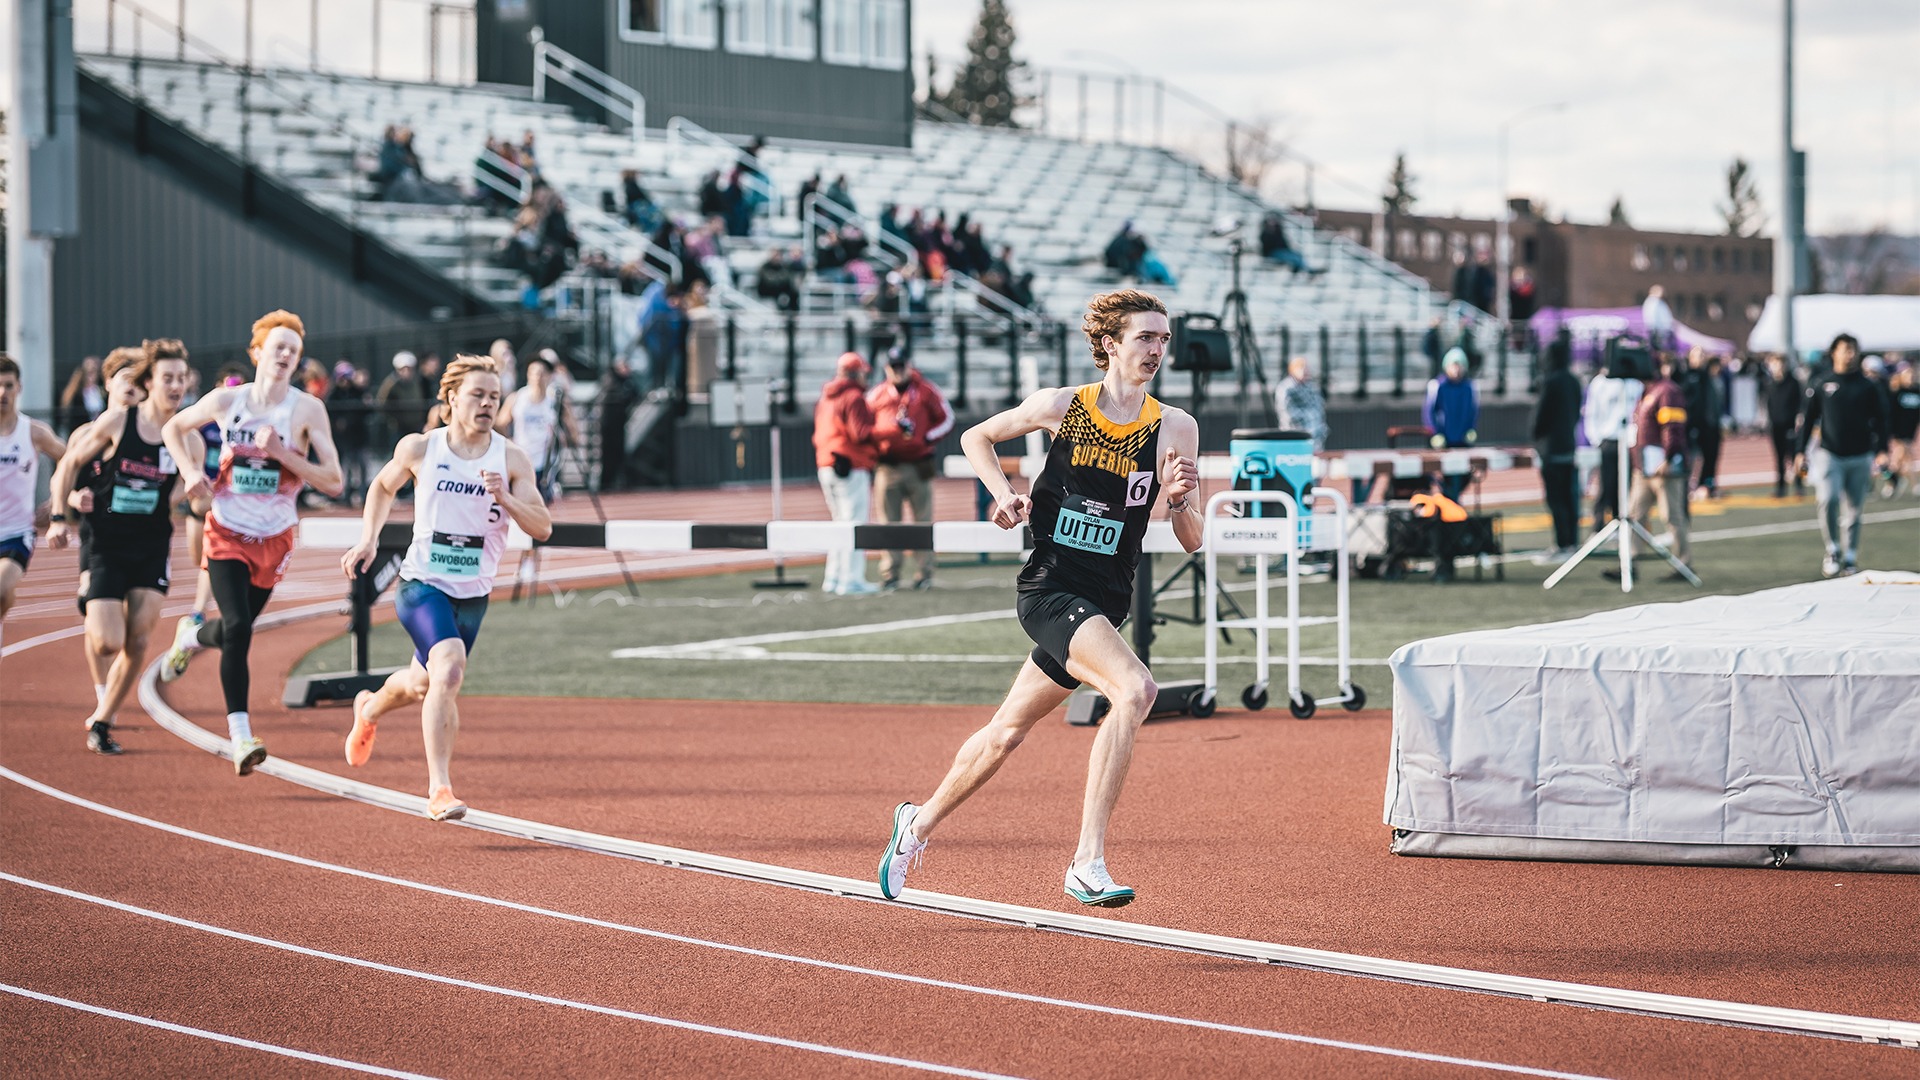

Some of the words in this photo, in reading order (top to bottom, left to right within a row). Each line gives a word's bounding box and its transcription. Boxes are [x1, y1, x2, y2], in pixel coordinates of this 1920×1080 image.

[1071, 444, 1139, 481] SUPERIOR
[437, 480, 486, 497] CROWN
[1130, 475, 1150, 501] 6
[488, 502, 501, 523] 5
[1084, 515, 1101, 524] DYLAN
[1060, 515, 1116, 546] UITTO
[431, 552, 480, 567] SWOBODA
